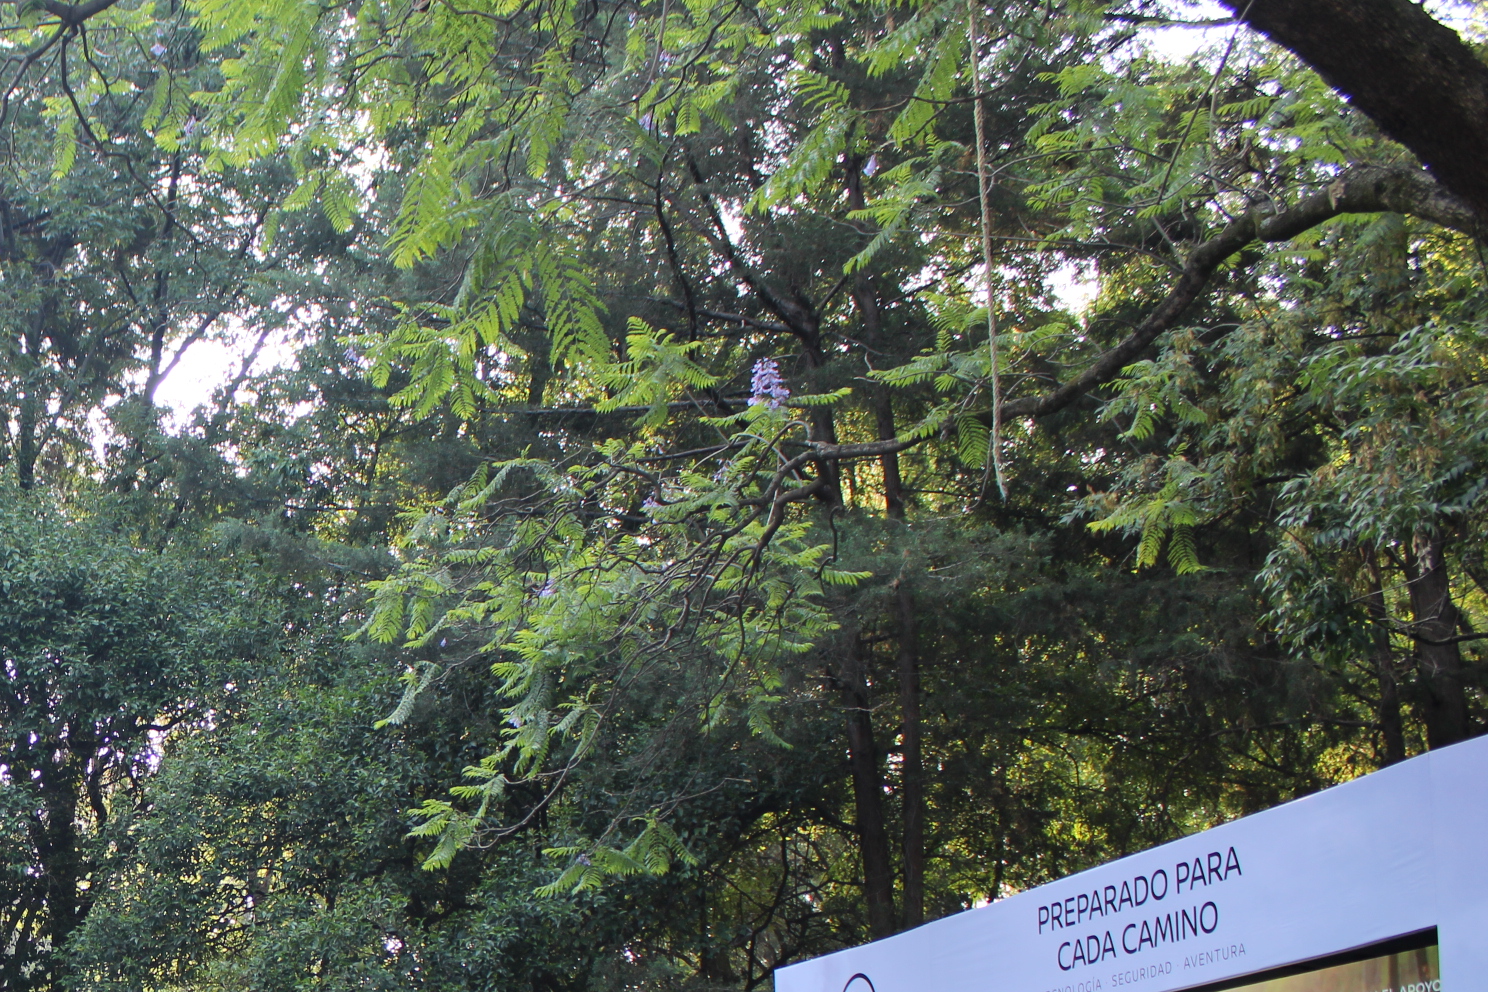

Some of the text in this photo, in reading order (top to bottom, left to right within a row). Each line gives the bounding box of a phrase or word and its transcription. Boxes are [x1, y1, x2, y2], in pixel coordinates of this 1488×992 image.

[1038, 846, 1242, 935] PREPARADO PARA
[1057, 901, 1219, 972] CADA CAMINO
[1111, 961, 1172, 988] SEGURIDAD
[1183, 942, 1246, 970] AVENTURA
